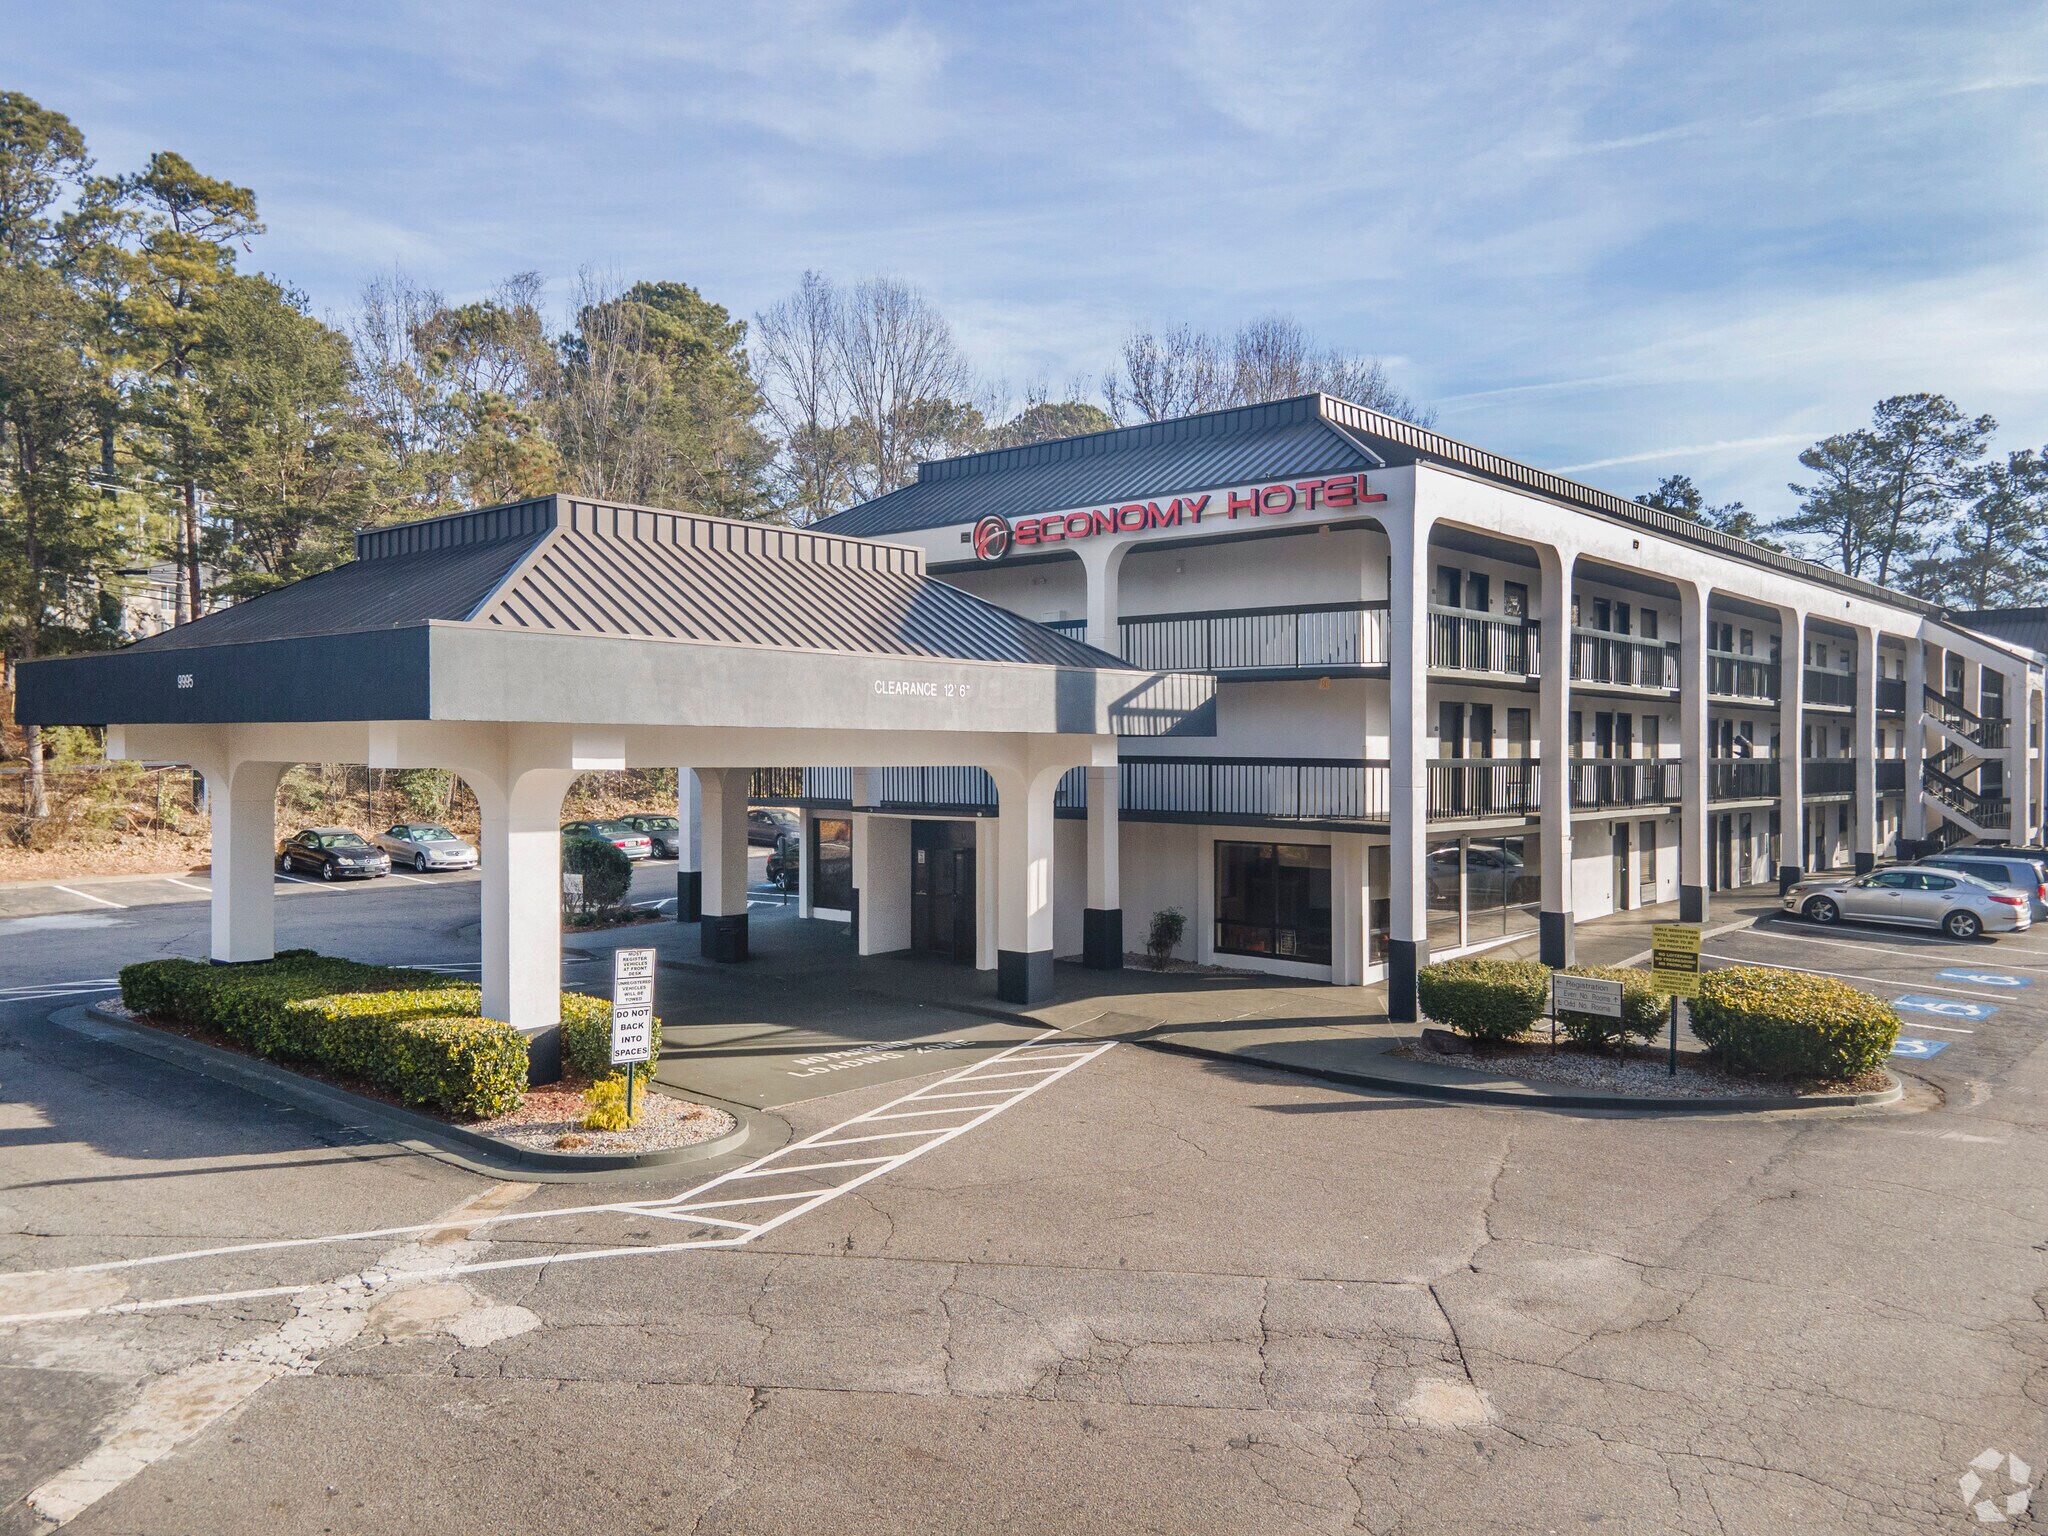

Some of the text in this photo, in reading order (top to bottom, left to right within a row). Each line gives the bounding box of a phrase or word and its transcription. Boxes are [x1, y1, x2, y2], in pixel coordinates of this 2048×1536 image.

[1015, 473, 1387, 546] ECONOMY HOTEL
[874, 680, 937, 697] CLEARANCE
[944, 684, 957, 697] 12'
[1565, 979, 1609, 992] Registration
[1563, 989, 1577, 998] Even
[1591, 993, 1611, 1003] Rooms
[1563, 999, 1576, 1008] Odd
[1591, 1003, 1611, 1012] Rooms
[631, 1009, 649, 1017] NOT
[620, 1022, 644, 1031] BACK
[621, 1035, 643, 1043] INTO
[615, 1046, 648, 1057] SPACES
[793, 1040, 913, 1066] NO PARKING
[788, 1039, 976, 1078] LOADING ZONE
